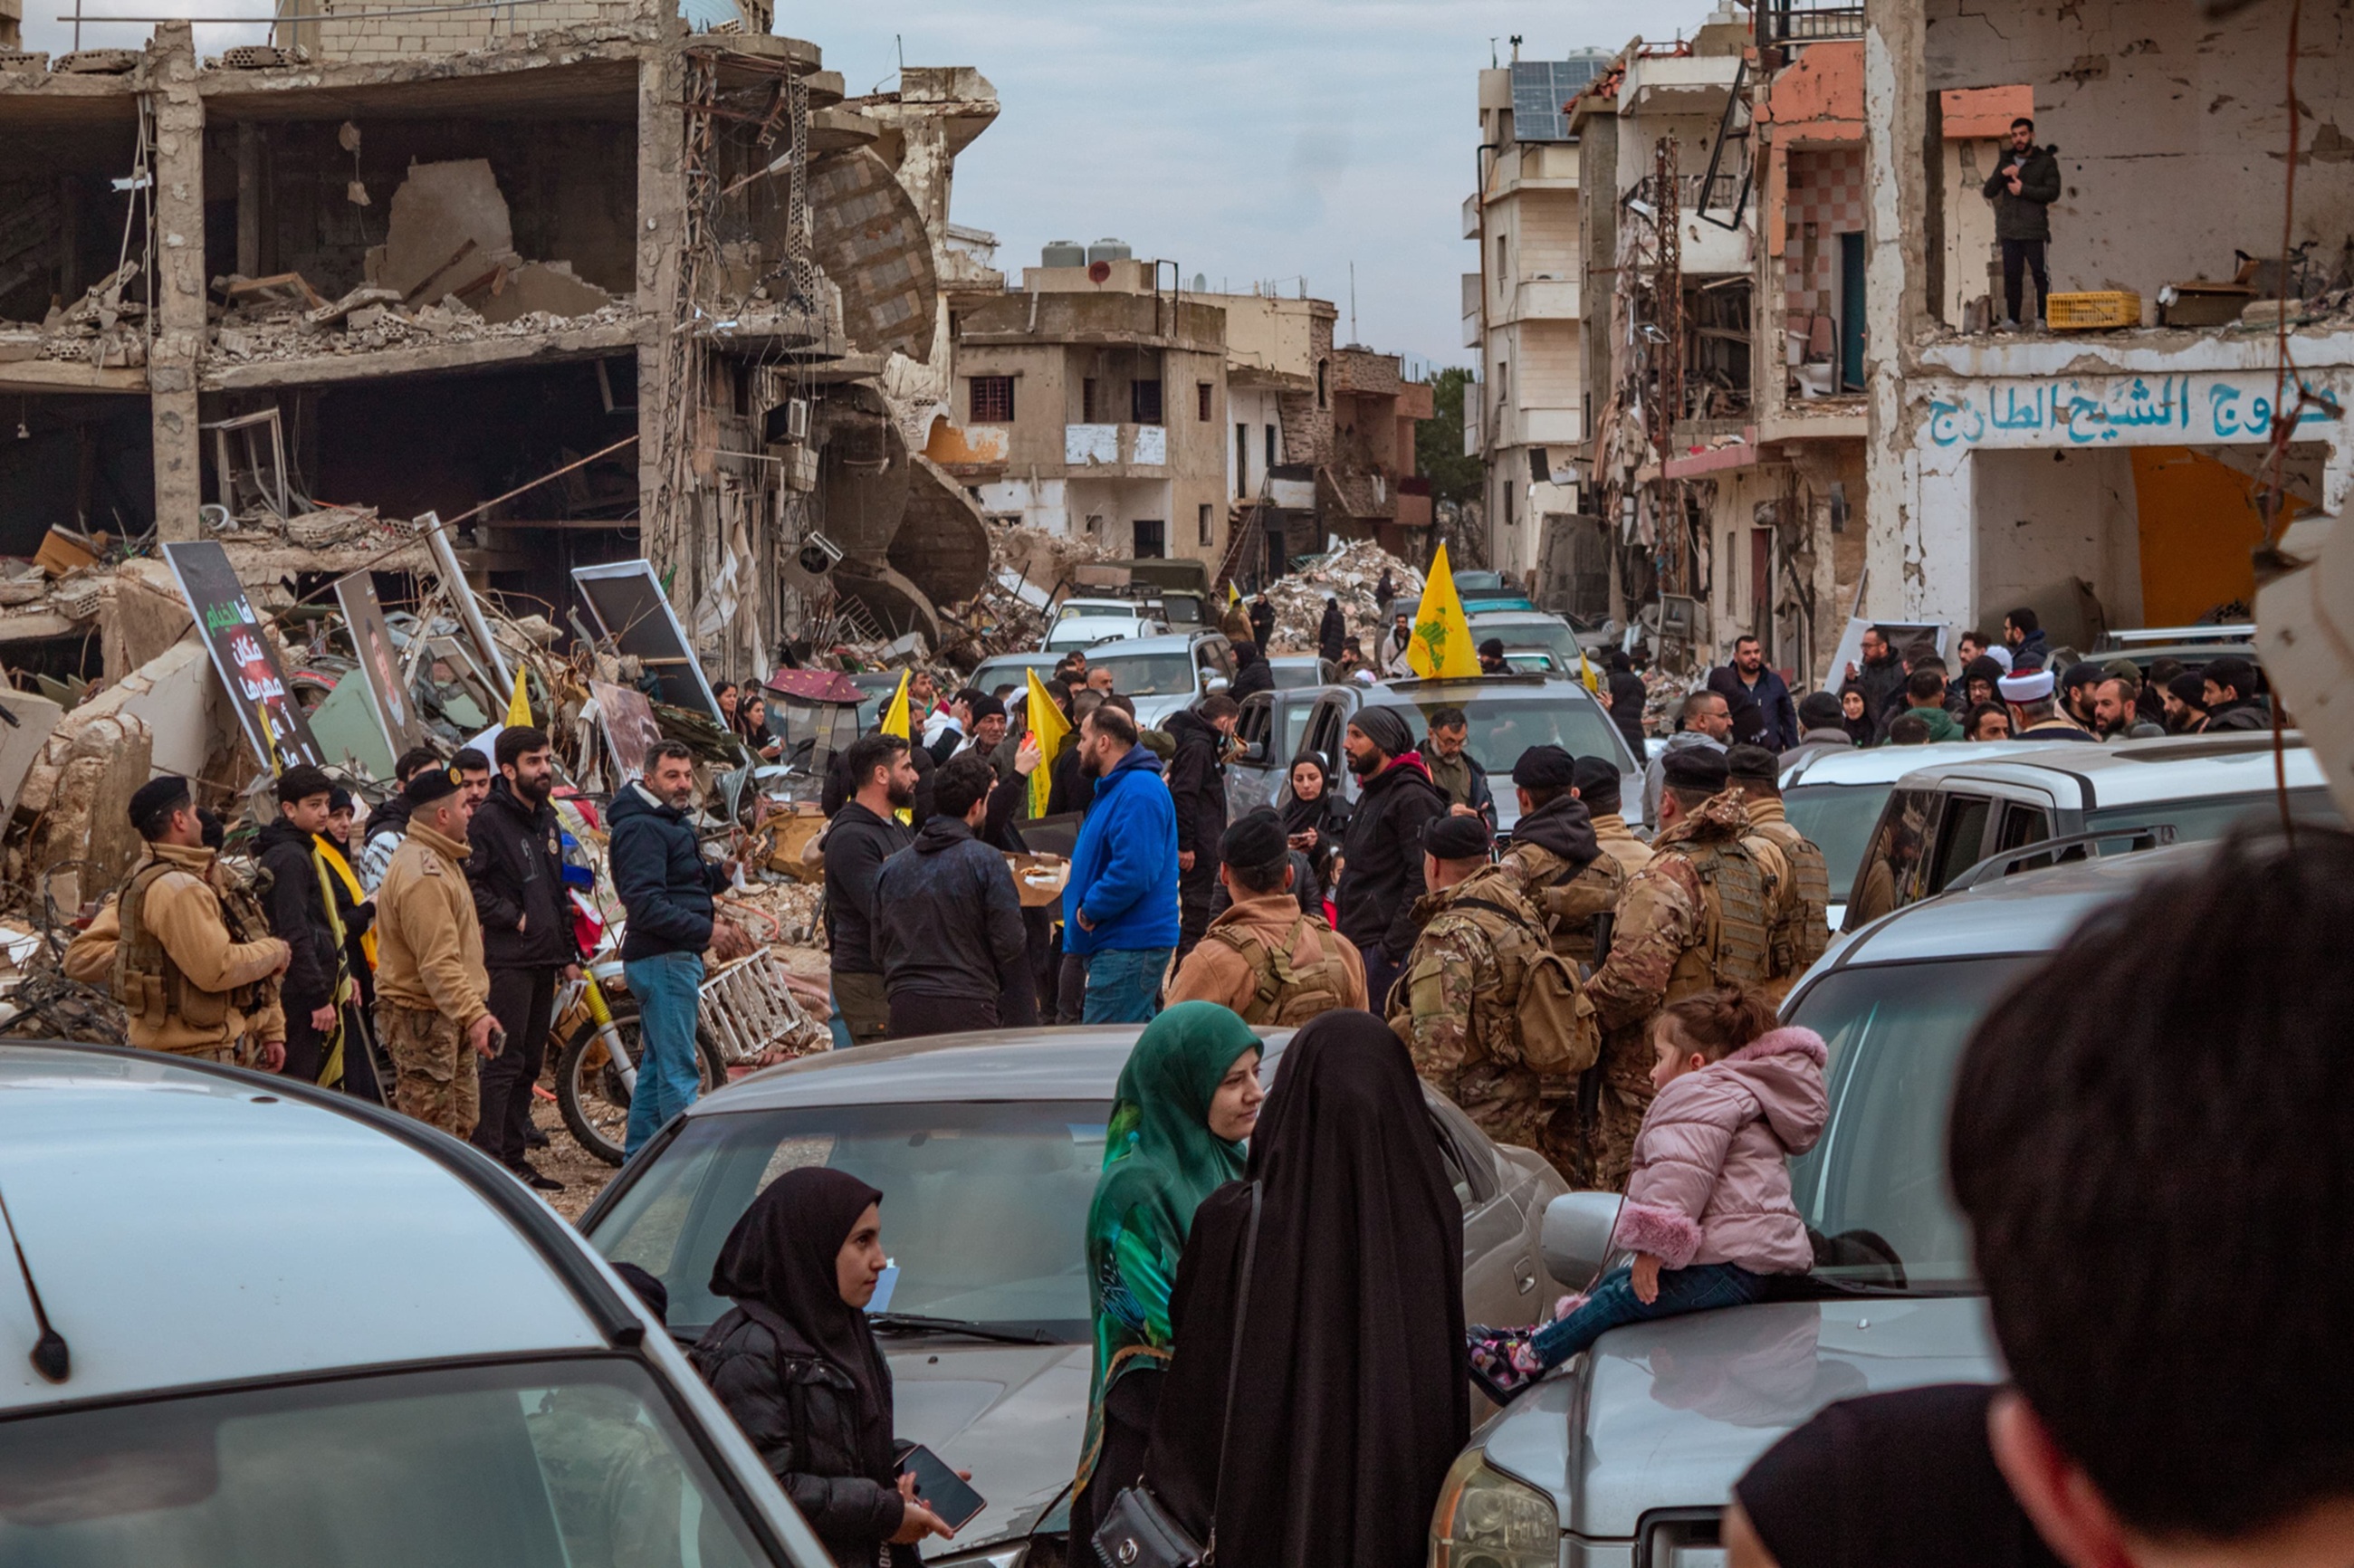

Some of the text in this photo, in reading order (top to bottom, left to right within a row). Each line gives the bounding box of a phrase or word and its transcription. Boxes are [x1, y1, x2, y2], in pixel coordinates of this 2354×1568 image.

[1929, 384, 2058, 447] الطازج
[206, 601, 243, 638] الخيام
[232, 635, 264, 668] فكان
[238, 675, 285, 705] مهرها
